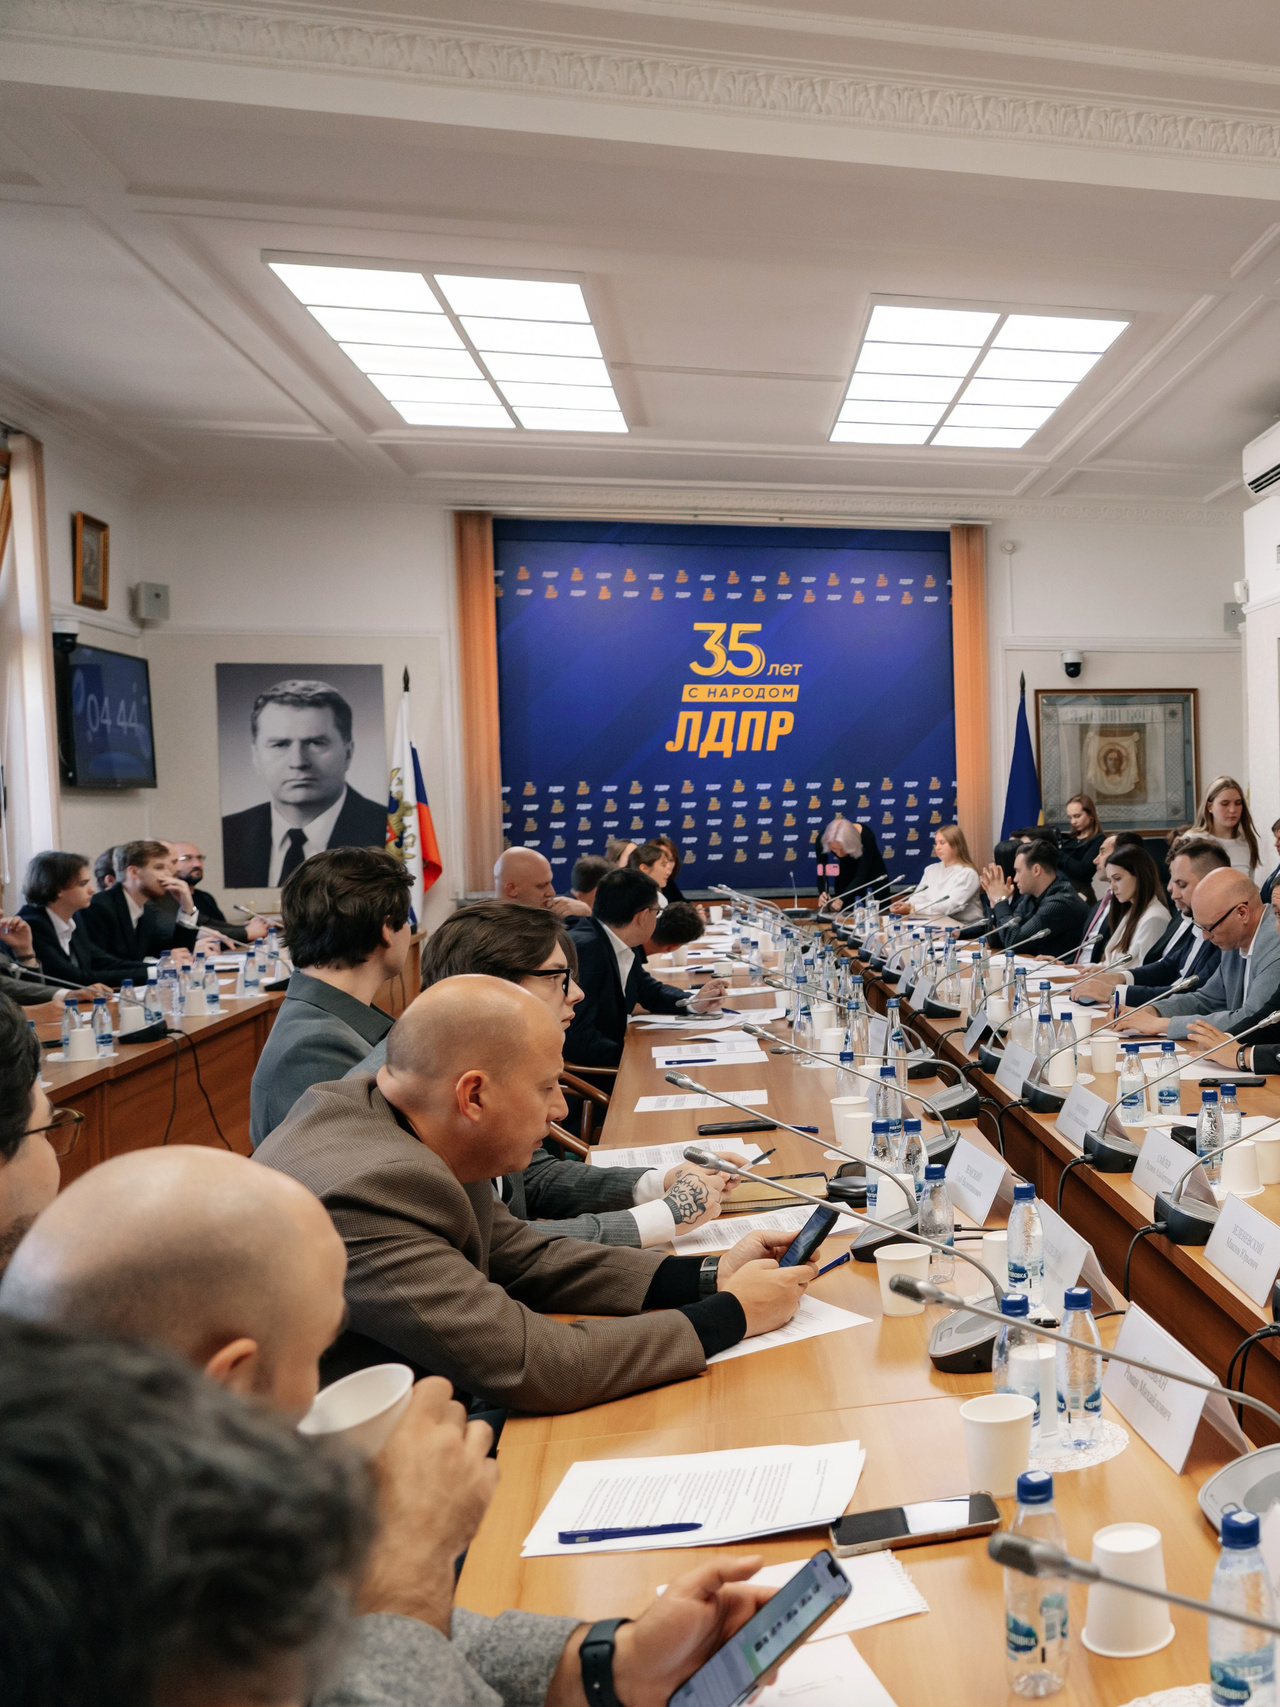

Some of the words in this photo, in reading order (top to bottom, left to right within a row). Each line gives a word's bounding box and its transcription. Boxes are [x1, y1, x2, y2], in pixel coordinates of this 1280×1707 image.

[689, 622, 766, 678] 35
[766, 663, 803, 677] лет
[687, 687, 698, 699] С
[707, 686, 795, 700] НАРОДОМ
[665, 710, 795, 759] ЛДПР
